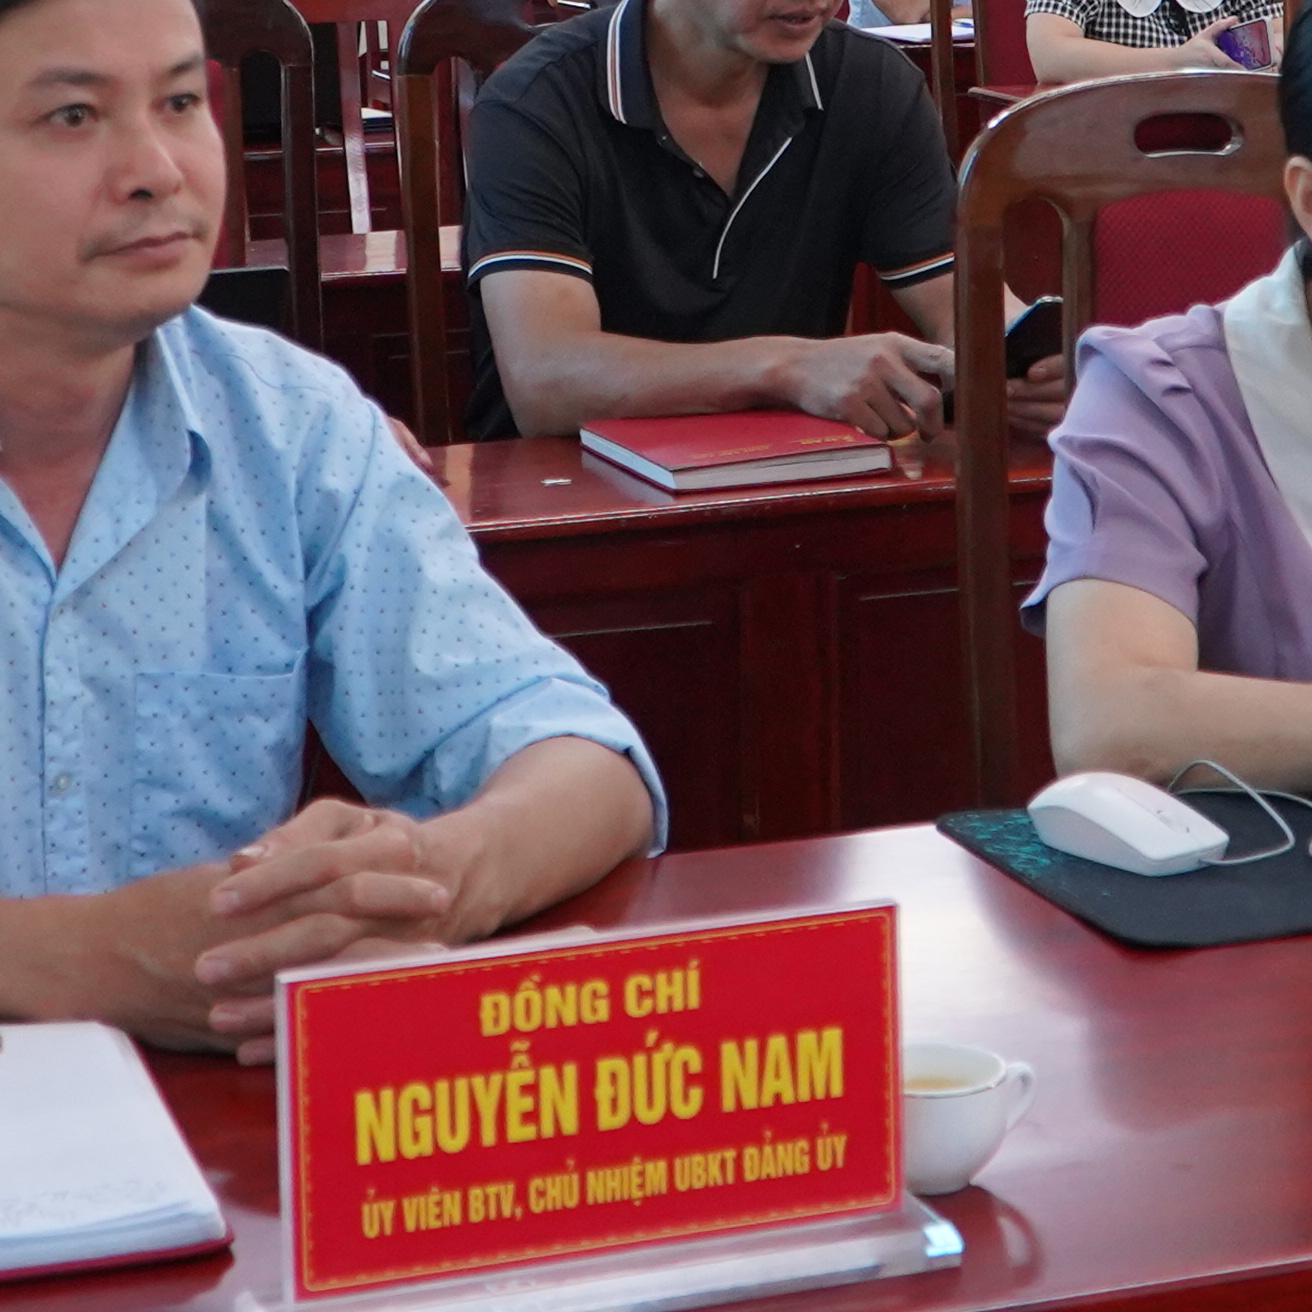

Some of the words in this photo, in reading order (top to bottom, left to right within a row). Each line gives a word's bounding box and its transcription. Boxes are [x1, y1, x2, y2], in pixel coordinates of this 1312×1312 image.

[480, 972, 610, 1037] ĐỒNG
[624, 958, 701, 1017] CHÍ
[355, 1041, 580, 1165] NGUYỄN
[594, 1030, 704, 1132] ĐỨC
[721, 1026, 844, 1112] NAM
[362, 1188, 396, 1238] ỦY
[402, 1186, 463, 1231] VIÊN
[468, 1183, 522, 1222] BTV,
[529, 1158, 580, 1214] CHỦ
[586, 1155, 668, 1206] NHIỆM
[674, 1148, 737, 1192] UBKT
[743, 1129, 810, 1182] ĐẢNG
[816, 1121, 848, 1171] ỦY
